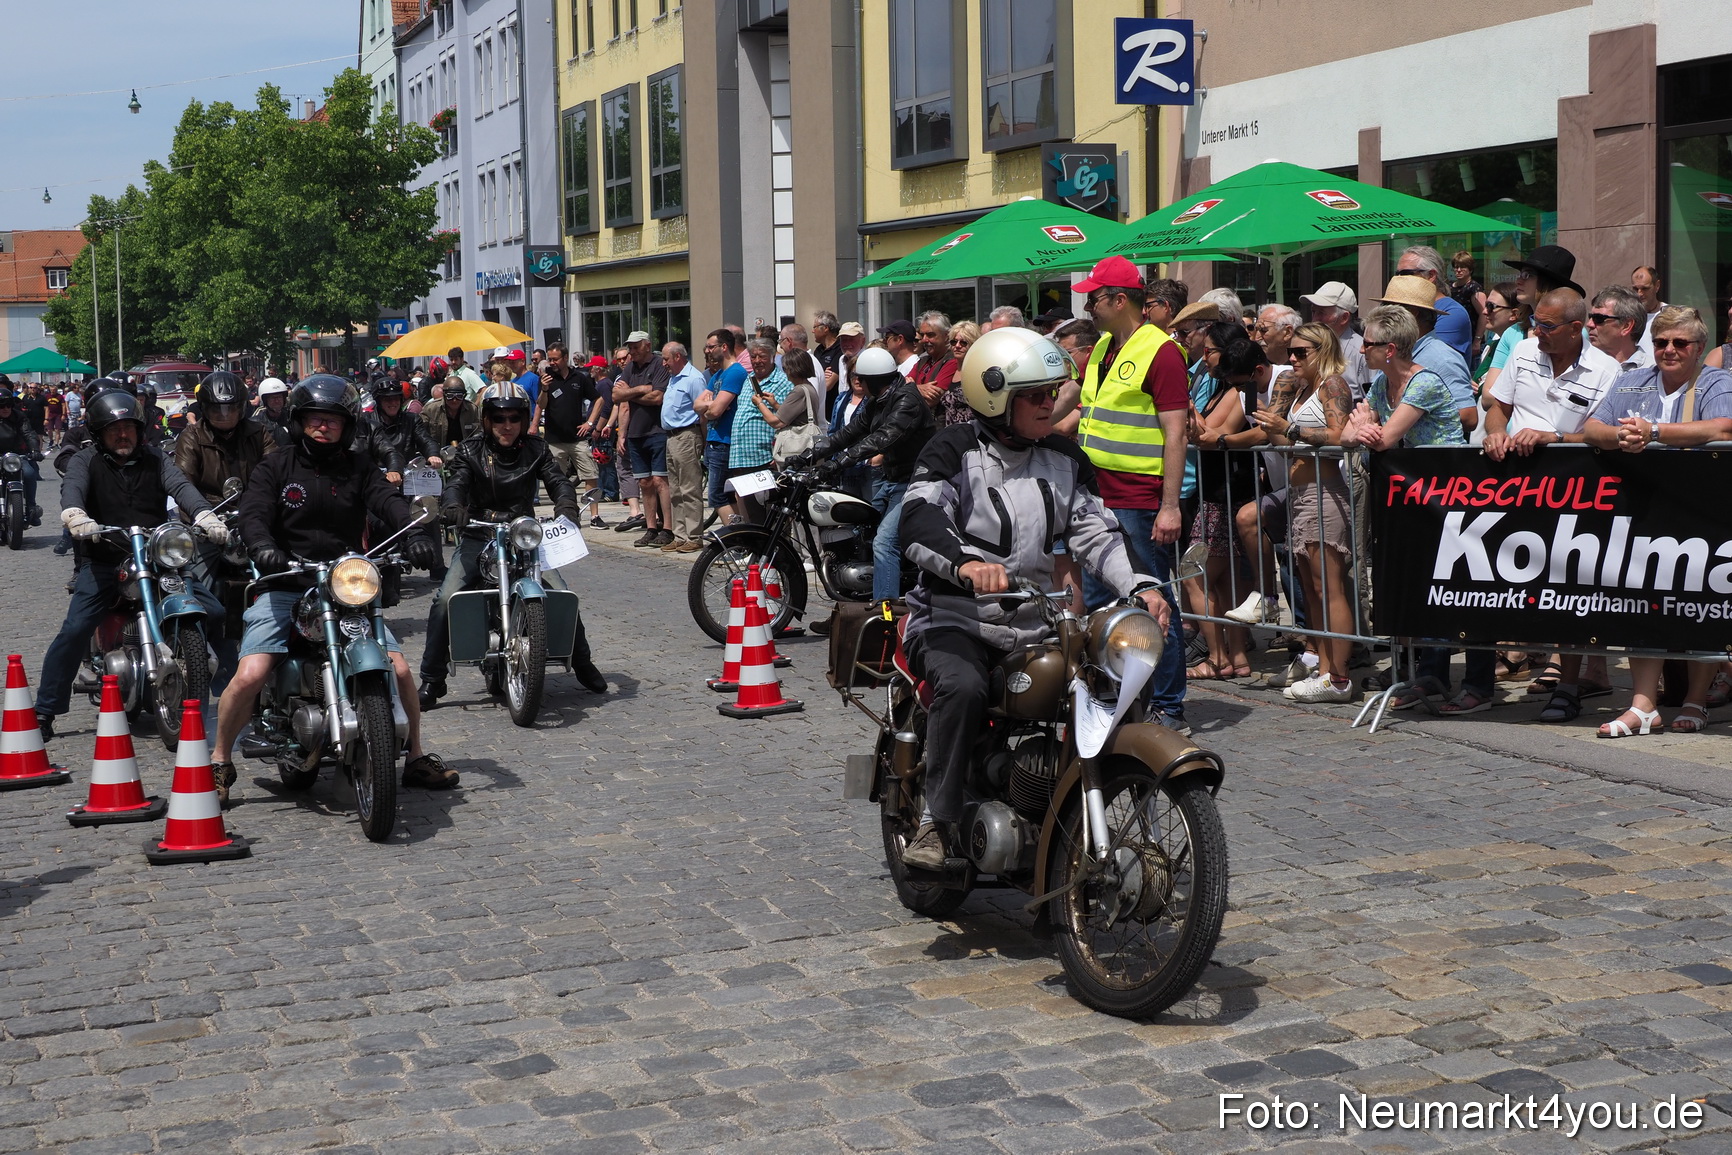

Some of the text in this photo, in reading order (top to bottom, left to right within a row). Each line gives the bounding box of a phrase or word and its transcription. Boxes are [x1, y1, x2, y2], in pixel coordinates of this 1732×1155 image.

[1201, 120, 1259, 145] Unterer Markt 15
[1073, 165, 1099, 198] G2
[1311, 217, 1437, 234] Lammsbräu
[1317, 211, 1406, 223] Neumarkter
[1133, 226, 1202, 240] Neumarkter
[1104, 235, 1198, 254] Lammsbräu
[538, 256, 554, 274] G2
[421, 471, 437, 479] 265
[1387, 474, 1622, 511] FAHRSCHULE
[545, 524, 568, 540] 605
[1427, 585, 1732, 623] Neumarkt Burgthann Freyst
